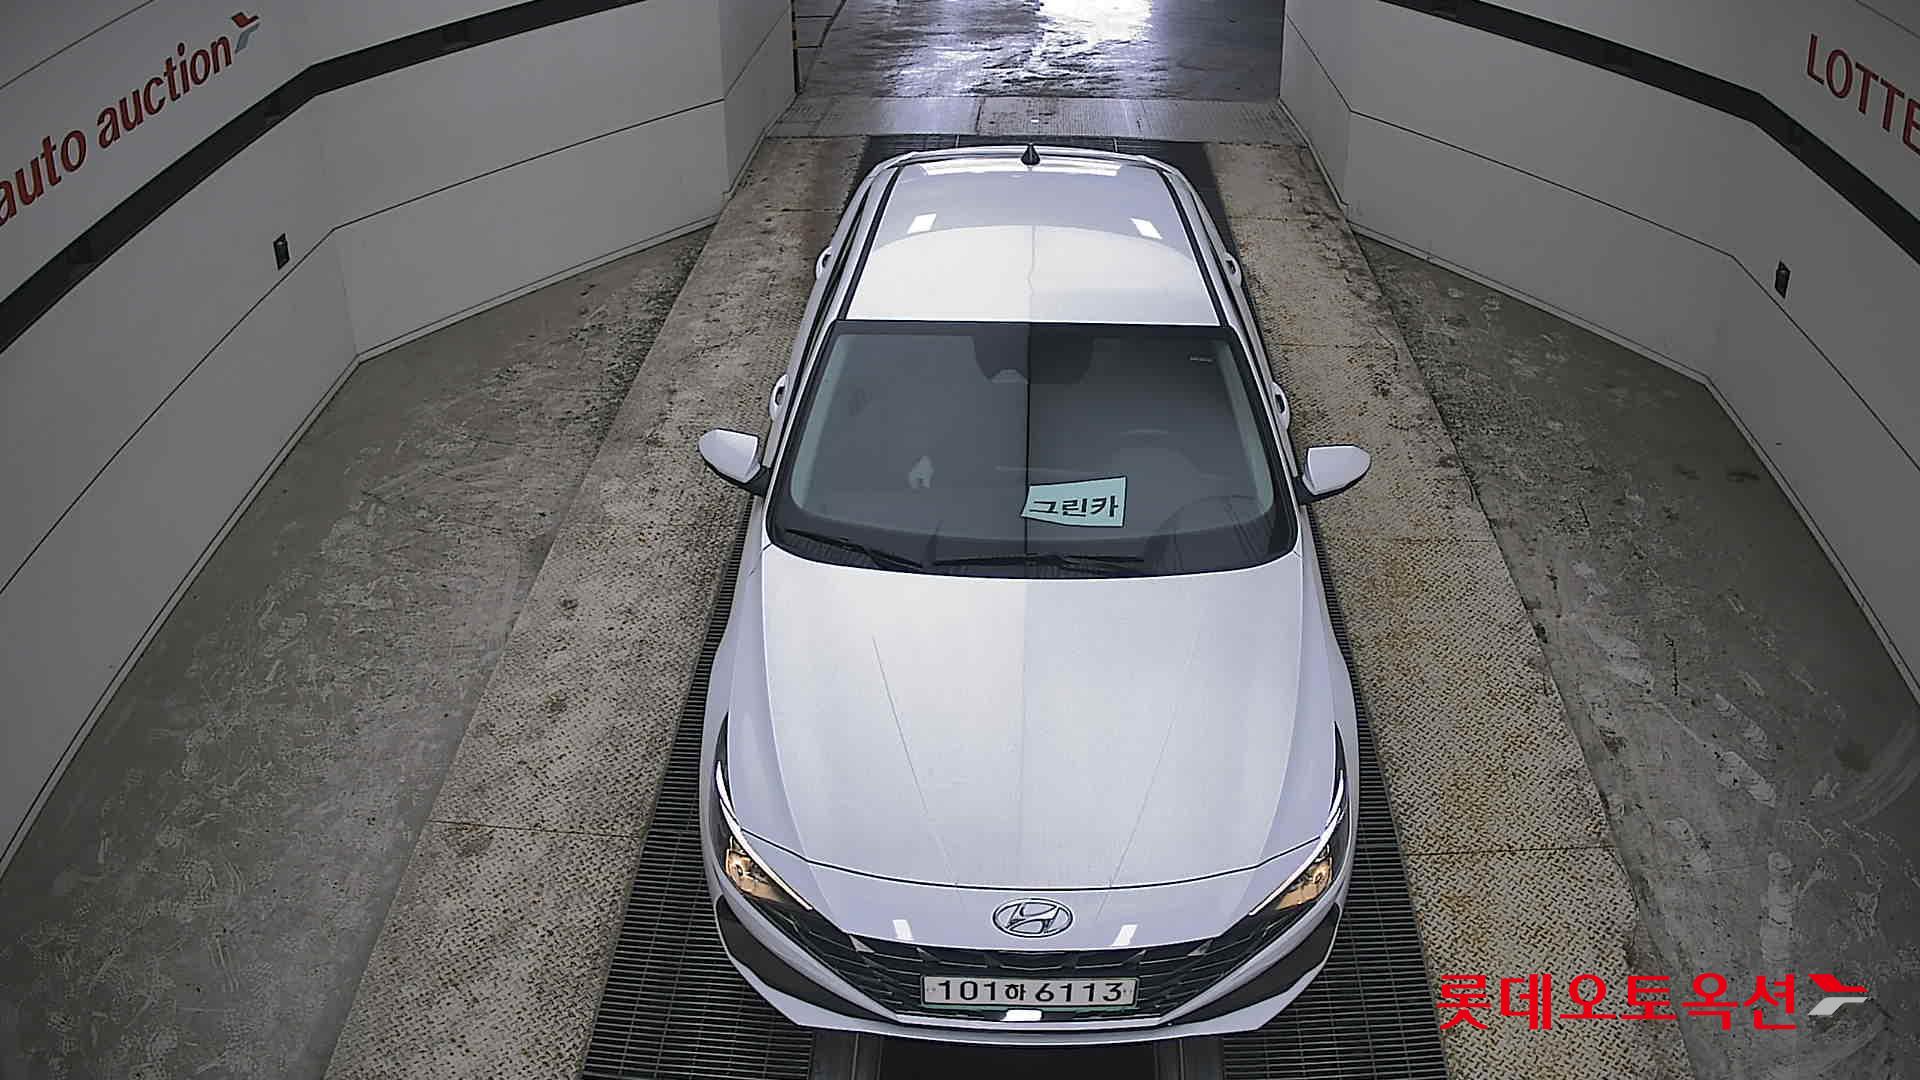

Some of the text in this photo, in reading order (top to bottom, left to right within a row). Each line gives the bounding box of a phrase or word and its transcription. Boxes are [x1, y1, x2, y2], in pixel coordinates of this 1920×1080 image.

[0, 36, 233, 226] auto auction
[1807, 33, 1920, 156] LOTTE
[1029, 495, 1119, 517] 그린카
